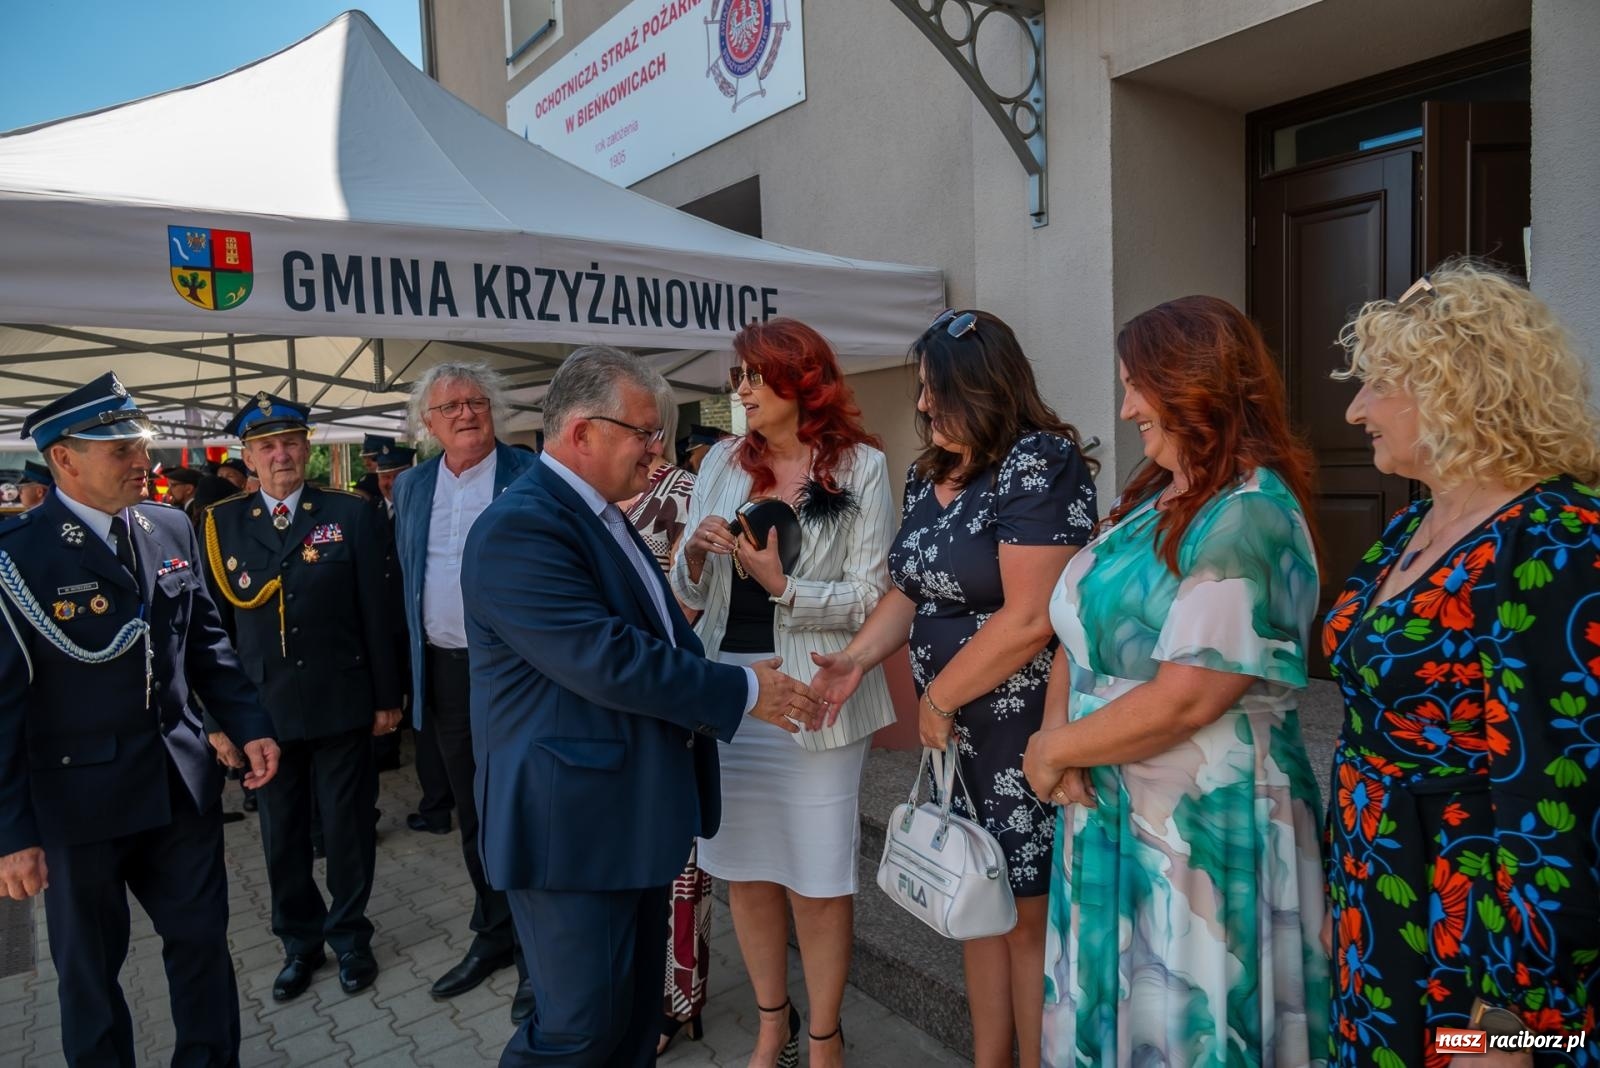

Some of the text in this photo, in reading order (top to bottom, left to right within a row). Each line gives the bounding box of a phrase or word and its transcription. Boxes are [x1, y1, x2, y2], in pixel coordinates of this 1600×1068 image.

[535, 61, 599, 119] OCHOTNICZA
[601, 26, 640, 73] STRAŻ
[565, 52, 667, 134] W BIEŃKOWICACH
[282, 250, 459, 317] GMINA
[898, 872, 927, 909] FILA
